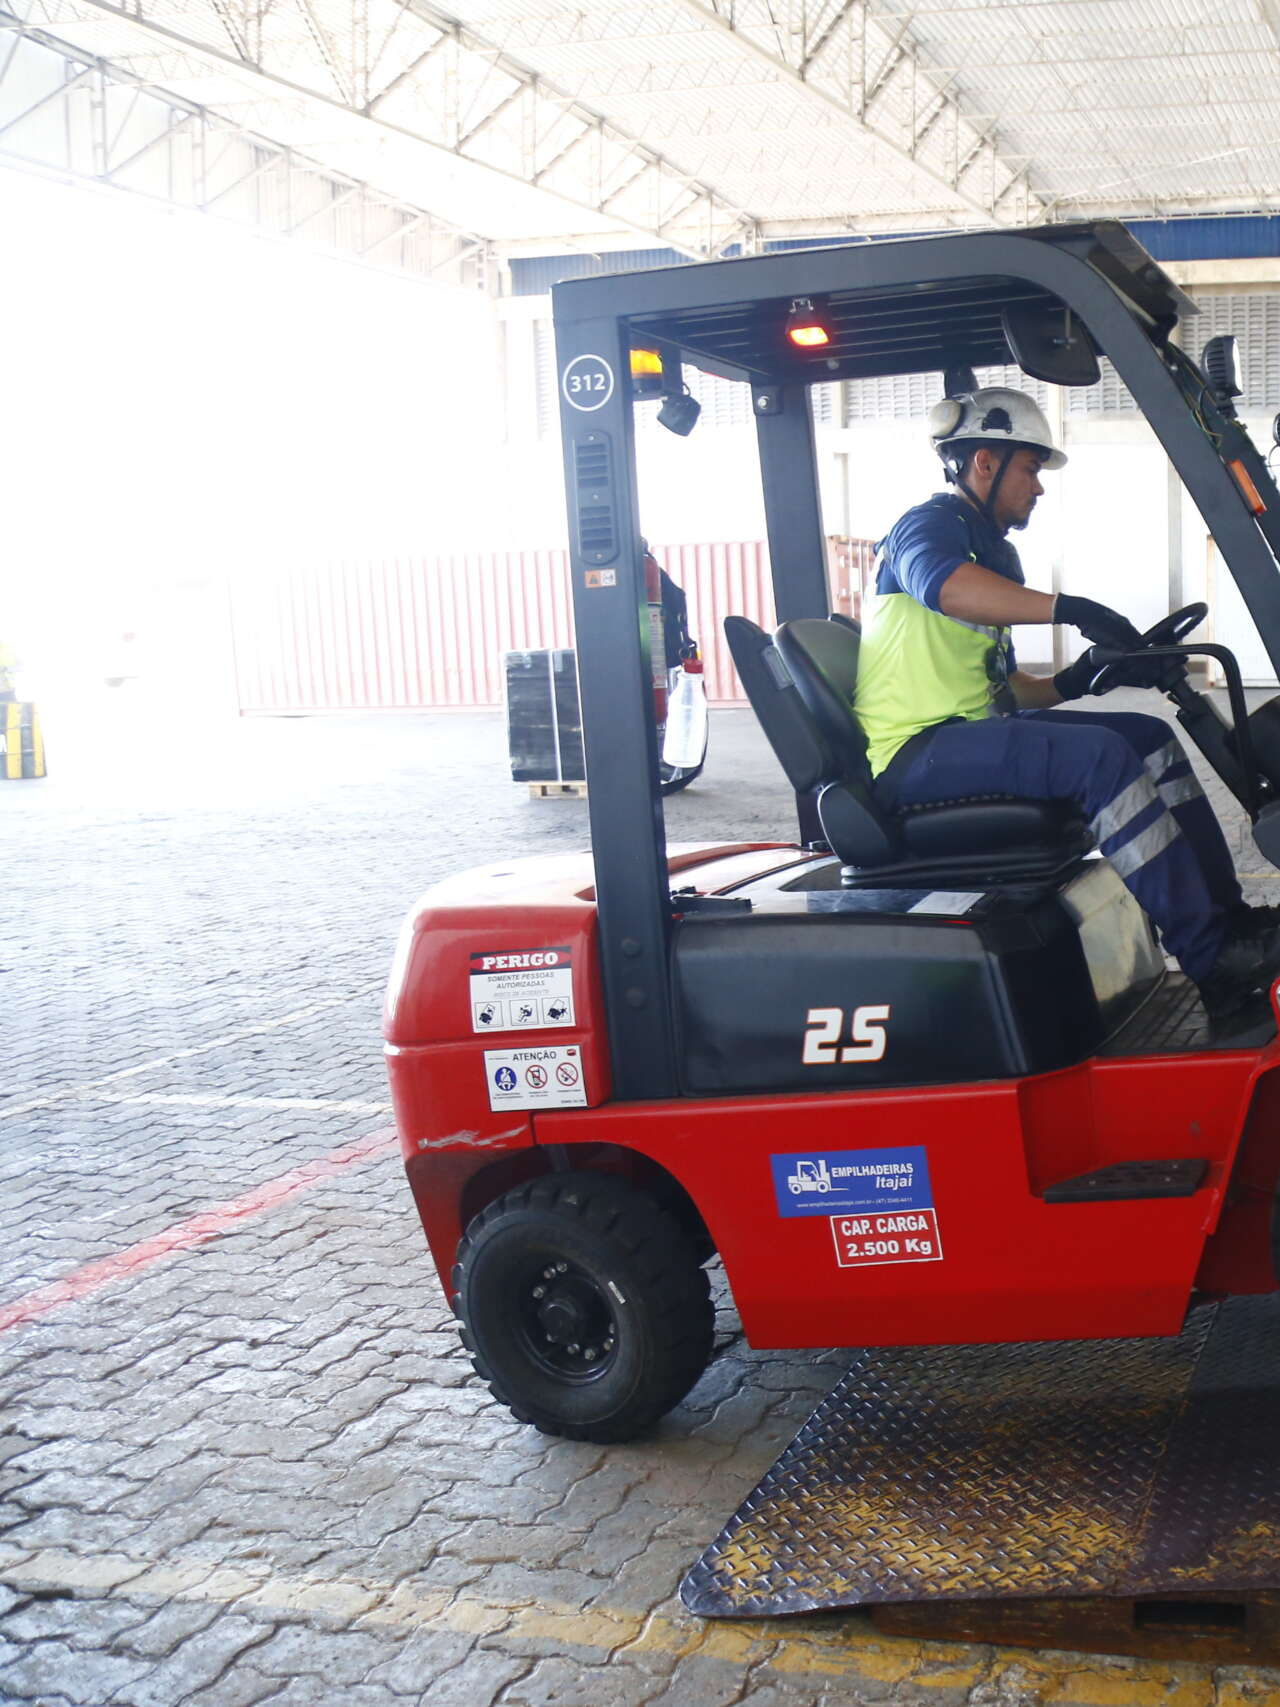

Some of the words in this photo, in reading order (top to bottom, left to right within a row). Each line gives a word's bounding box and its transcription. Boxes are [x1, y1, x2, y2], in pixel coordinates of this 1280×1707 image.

[570, 373, 606, 393] 312
[482, 952, 559, 970] PERIGO
[487, 974, 520, 983] SOMENTE
[521, 971, 555, 981] PESSOAS
[496, 980, 545, 990] AUTORIZADAS
[802, 1004, 891, 1065] 25
[512, 1050, 557, 1062] ATENÇÃO
[831, 1163, 914, 1178] EMPILHADEIRAS
[875, 1175, 913, 1191] Itajaí
[840, 1219, 874, 1236] CAP.
[876, 1215, 929, 1234] CARGA
[846, 1240, 900, 1257] 2.500
[904, 1238, 933, 1256] Kg
